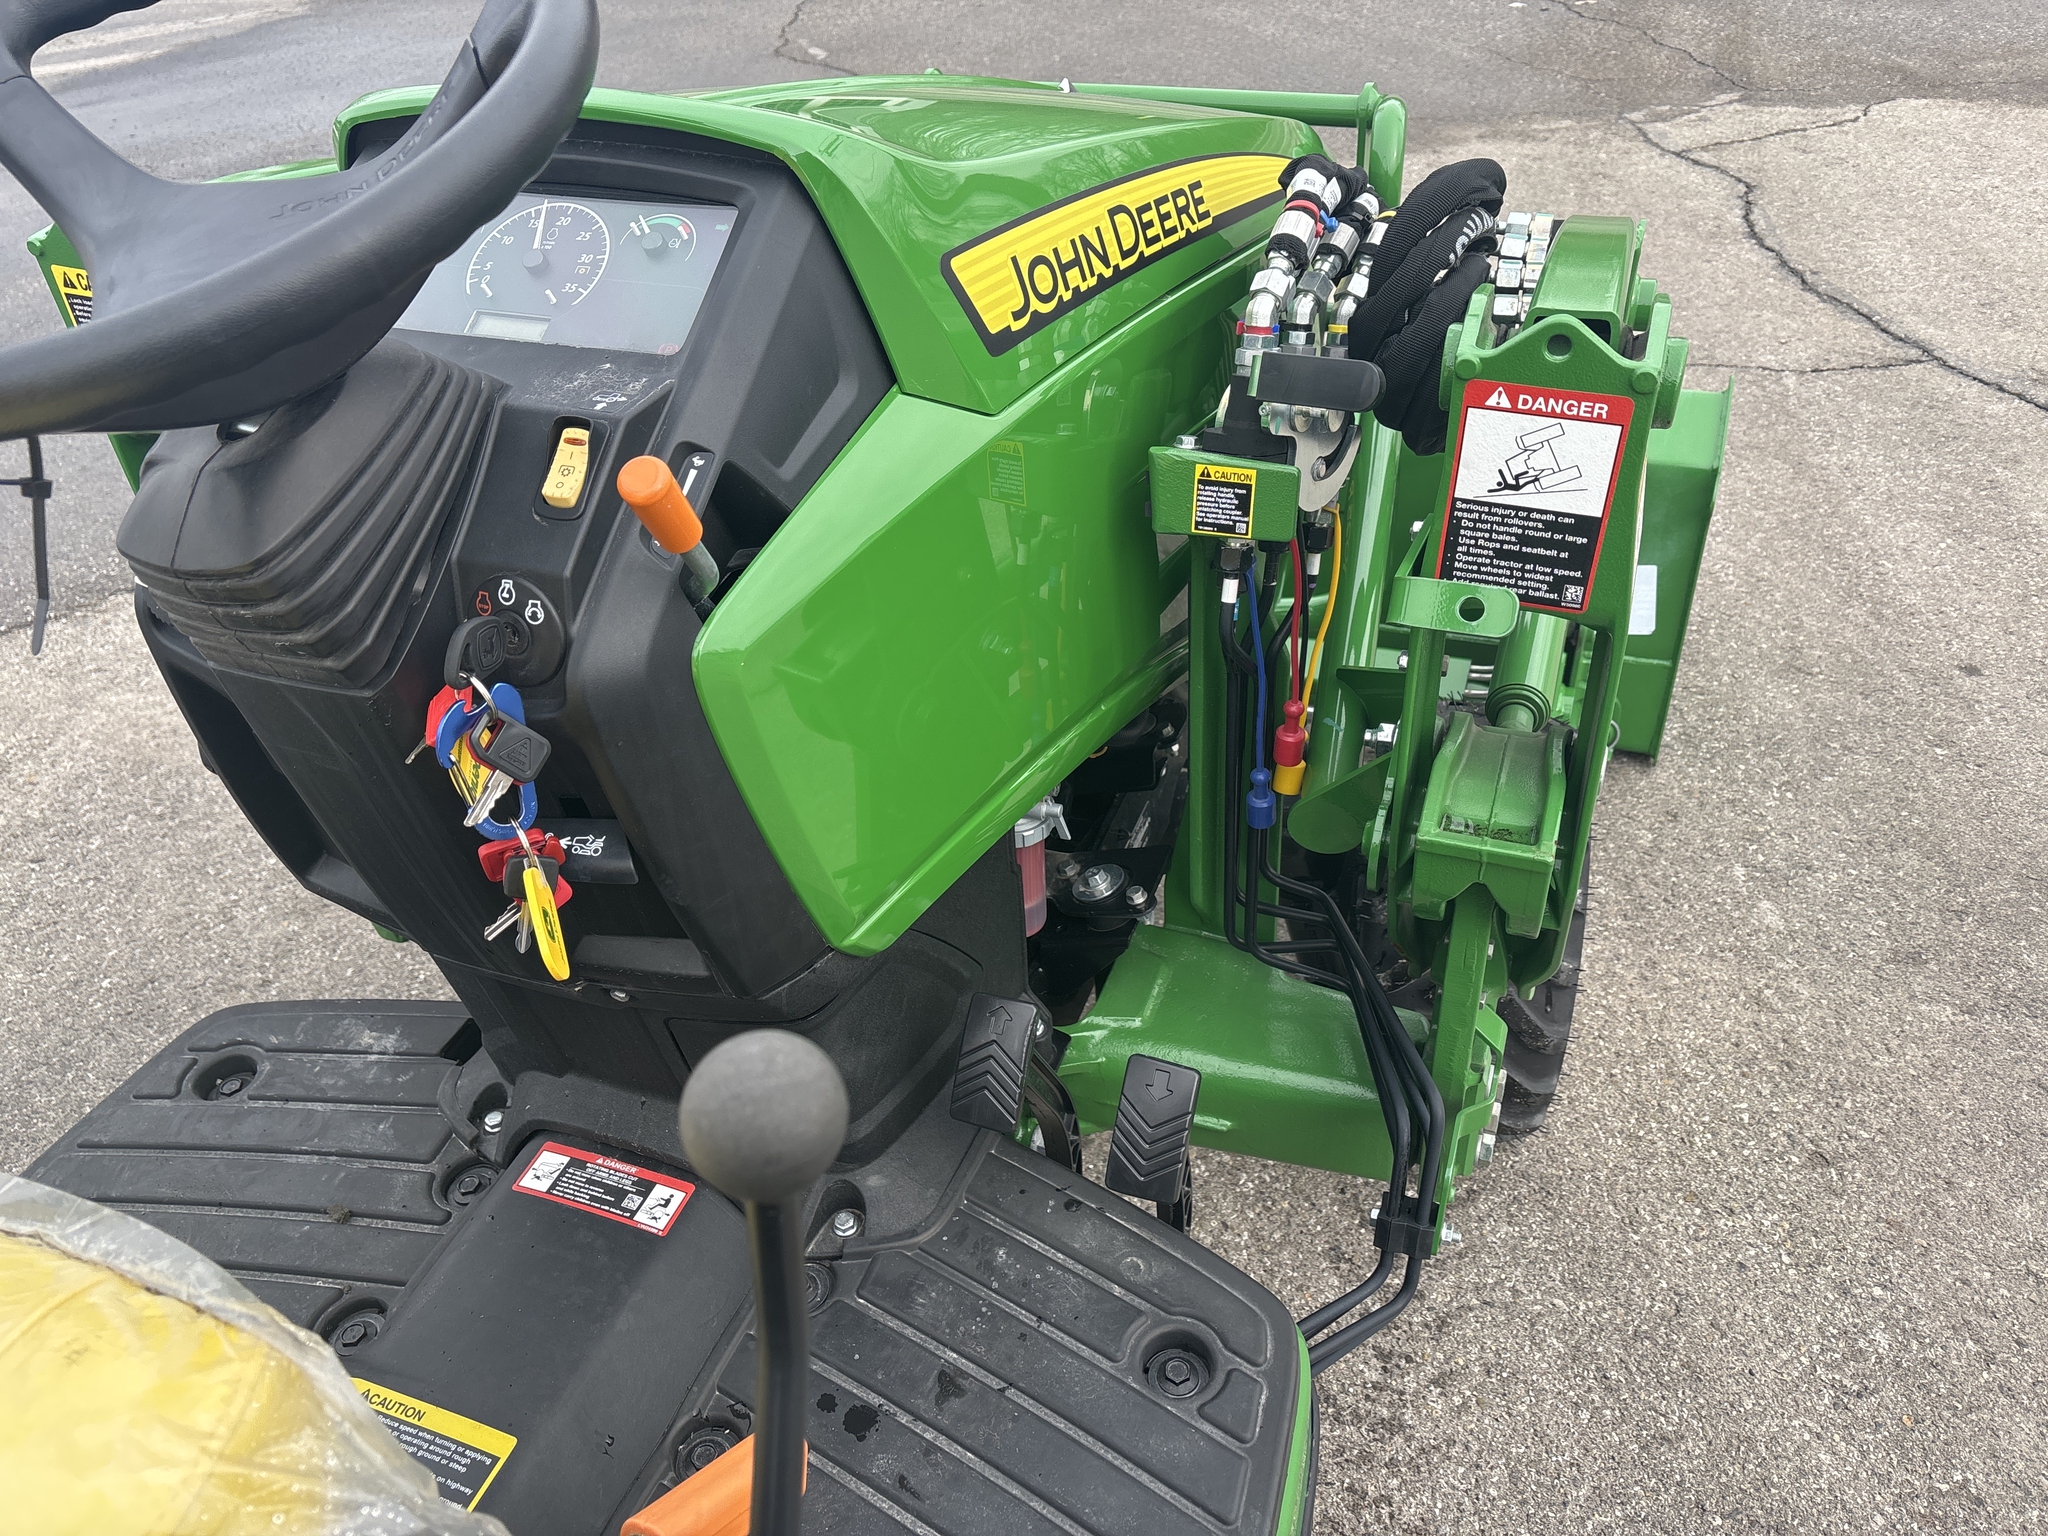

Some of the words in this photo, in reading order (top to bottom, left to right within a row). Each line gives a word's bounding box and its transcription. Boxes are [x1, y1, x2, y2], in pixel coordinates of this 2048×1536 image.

[528, 218, 540, 228] 15
[556, 216, 572, 226] 20
[500, 236, 514, 246] 10
[576, 231, 592, 242] 25
[578, 254, 594, 264] 30
[1010, 225, 1113, 325] JOHN
[1106, 179, 1213, 265] DEERE
[484, 262, 493, 270] 5
[481, 275, 490, 284] 0
[562, 282, 578, 292] 35
[1517, 394, 1608, 419] DANGER
[1214, 470, 1252, 482] CAUTION
[1454, 511, 1479, 519] result
[1482, 514, 1502, 522] from
[1504, 517, 1545, 528] rollovers.
[1456, 501, 1489, 512] Serious
[1491, 506, 1516, 517] injury
[1530, 511, 1555, 522] death
[1460, 529, 1490, 539] square
[1492, 532, 1518, 542] bales.
[1493, 524, 1522, 534] handle
[1525, 529, 1551, 538] round
[1565, 534, 1587, 544] large
[1458, 537, 1476, 545] Use
[1478, 540, 1500, 549] Rops
[1503, 543, 1520, 551] and
[1522, 546, 1557, 557] seatbelt
[1470, 546, 1496, 556] times.
[1454, 561, 1478, 570] Move
[1480, 565, 1510, 575] wheels
[1524, 571, 1554, 581] widest
[1456, 553, 1491, 564] Operate
[1493, 558, 1522, 568] tractor
[1536, 564, 1551, 572] low
[1554, 567, 1583, 578] speed.
[1453, 570, 1516, 584] recommended
[1517, 579, 1550, 590] setting.
[1529, 589, 1559, 600] ballast.
[604, 1160, 638, 1174] DANGER
[369, 1393, 426, 1422] CAUTION
[377, 1414, 398, 1428] Reduce
[399, 1423, 418, 1435] speed
[418, 1431, 434, 1441] when
[435, 1436, 456, 1450] turning
[464, 1449, 492, 1465] applying
[399, 1442, 417, 1454] rough
[417, 1448, 441, 1462] ground
[449, 1460, 467, 1473] steep
[400, 1433, 428, 1450] operating
[429, 1444, 450, 1457] around
[451, 1452, 471, 1465] rough
[445, 1479, 473, 1496] highway
